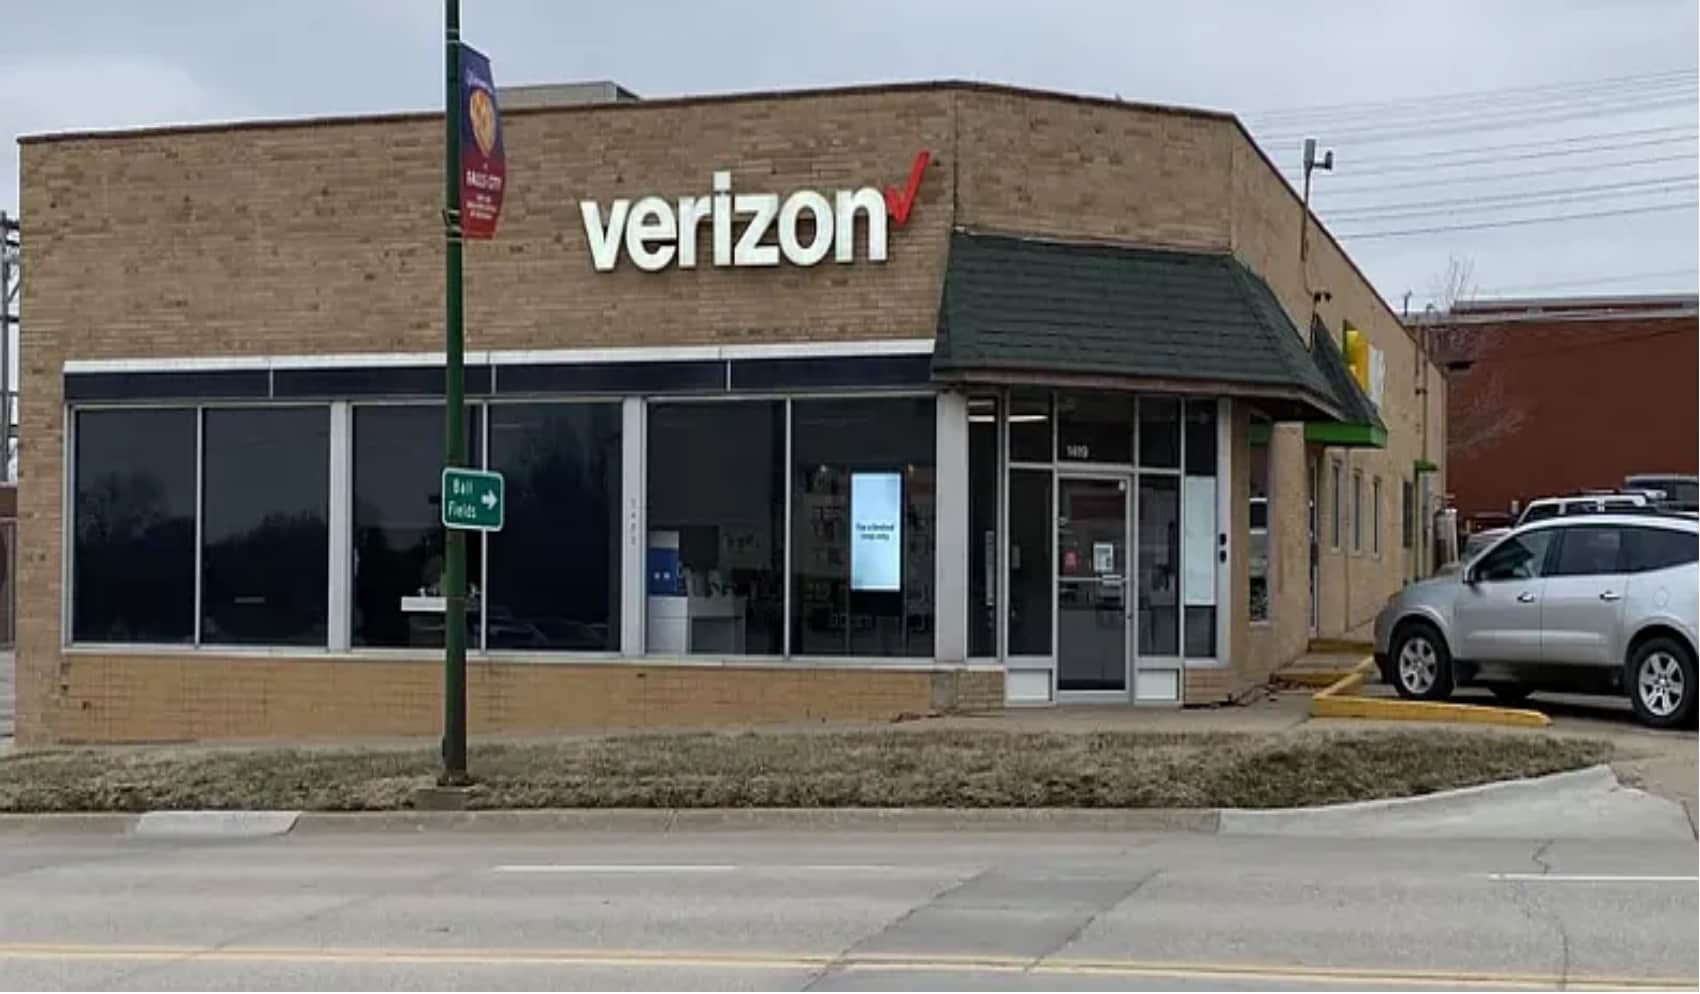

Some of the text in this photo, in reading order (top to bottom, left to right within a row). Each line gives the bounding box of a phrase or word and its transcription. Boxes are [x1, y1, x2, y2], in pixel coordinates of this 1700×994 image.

[580, 171, 888, 271] verizon
[453, 478, 473, 495] Ball
[448, 500, 477, 518] Fields
